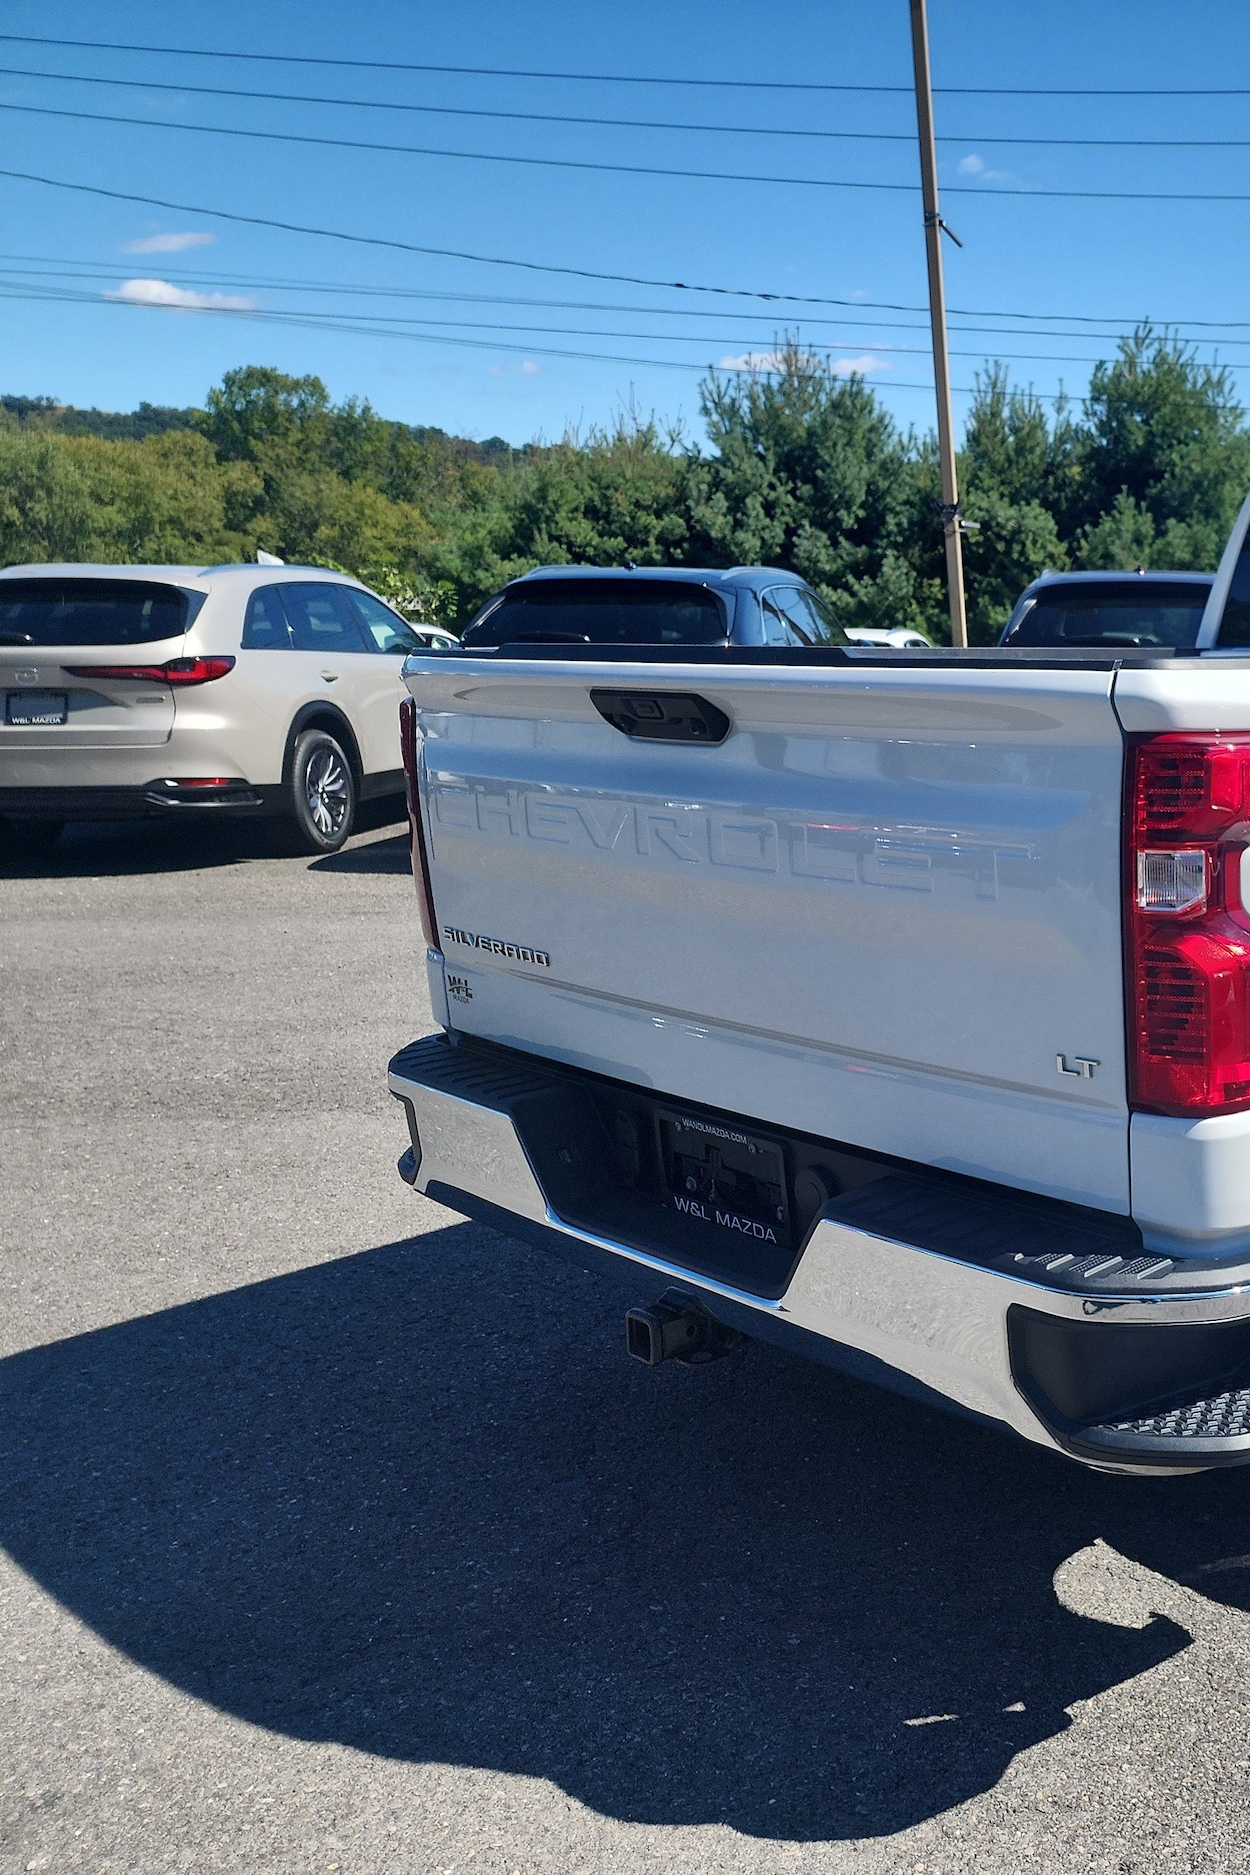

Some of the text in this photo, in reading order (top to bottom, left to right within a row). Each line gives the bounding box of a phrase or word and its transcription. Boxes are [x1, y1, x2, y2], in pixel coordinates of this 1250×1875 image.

[433, 782, 1031, 900] CHEVROLET
[443, 925, 550, 967] SILVERADO
[1056, 1053, 1101, 1079] LT
[681, 1118, 748, 1145] WANDLMAZDA.COM
[673, 1195, 778, 1245] W&L MAZDA
